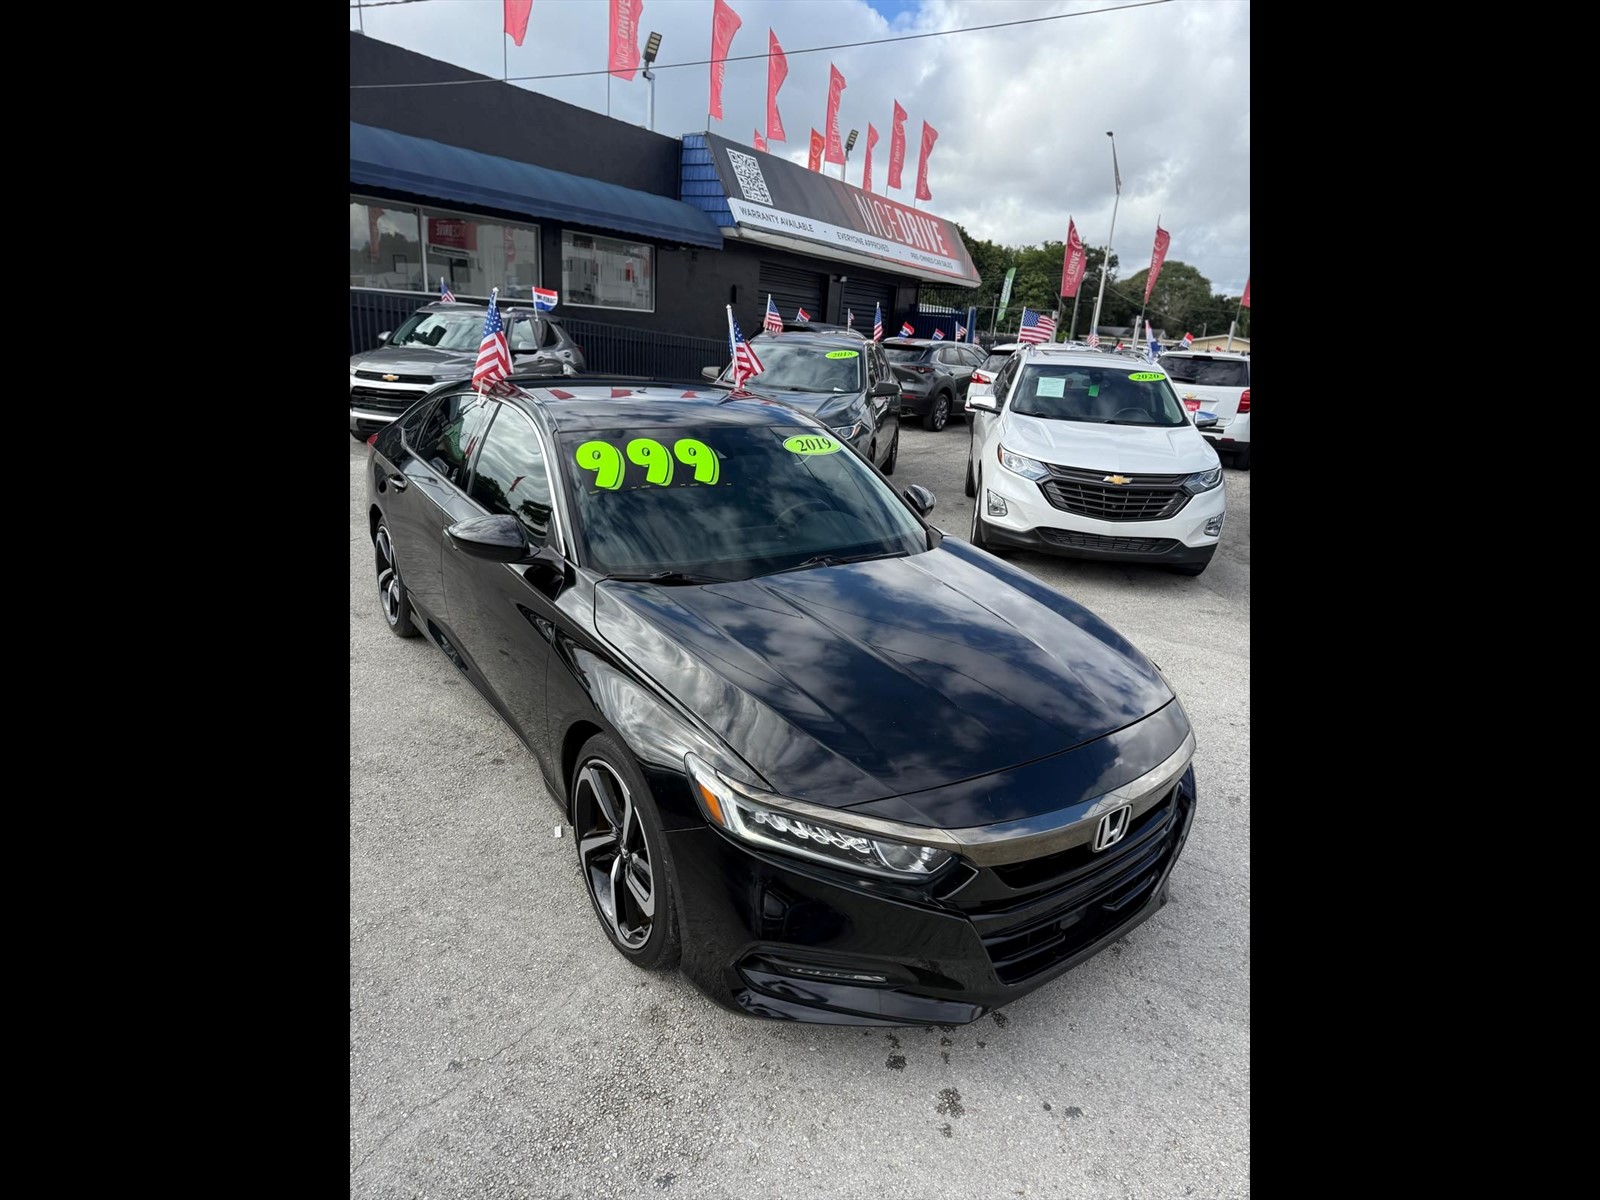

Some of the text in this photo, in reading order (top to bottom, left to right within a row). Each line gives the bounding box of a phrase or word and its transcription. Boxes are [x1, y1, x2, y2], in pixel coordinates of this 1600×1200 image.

[739, 207, 815, 232] WARRANTY AVAILABLE
[836, 231, 864, 246] EVERYONE
[1067, 250, 1081, 276] DRIVE
[1136, 373, 1160, 381] 2020
[796, 438, 832, 452] 2019
